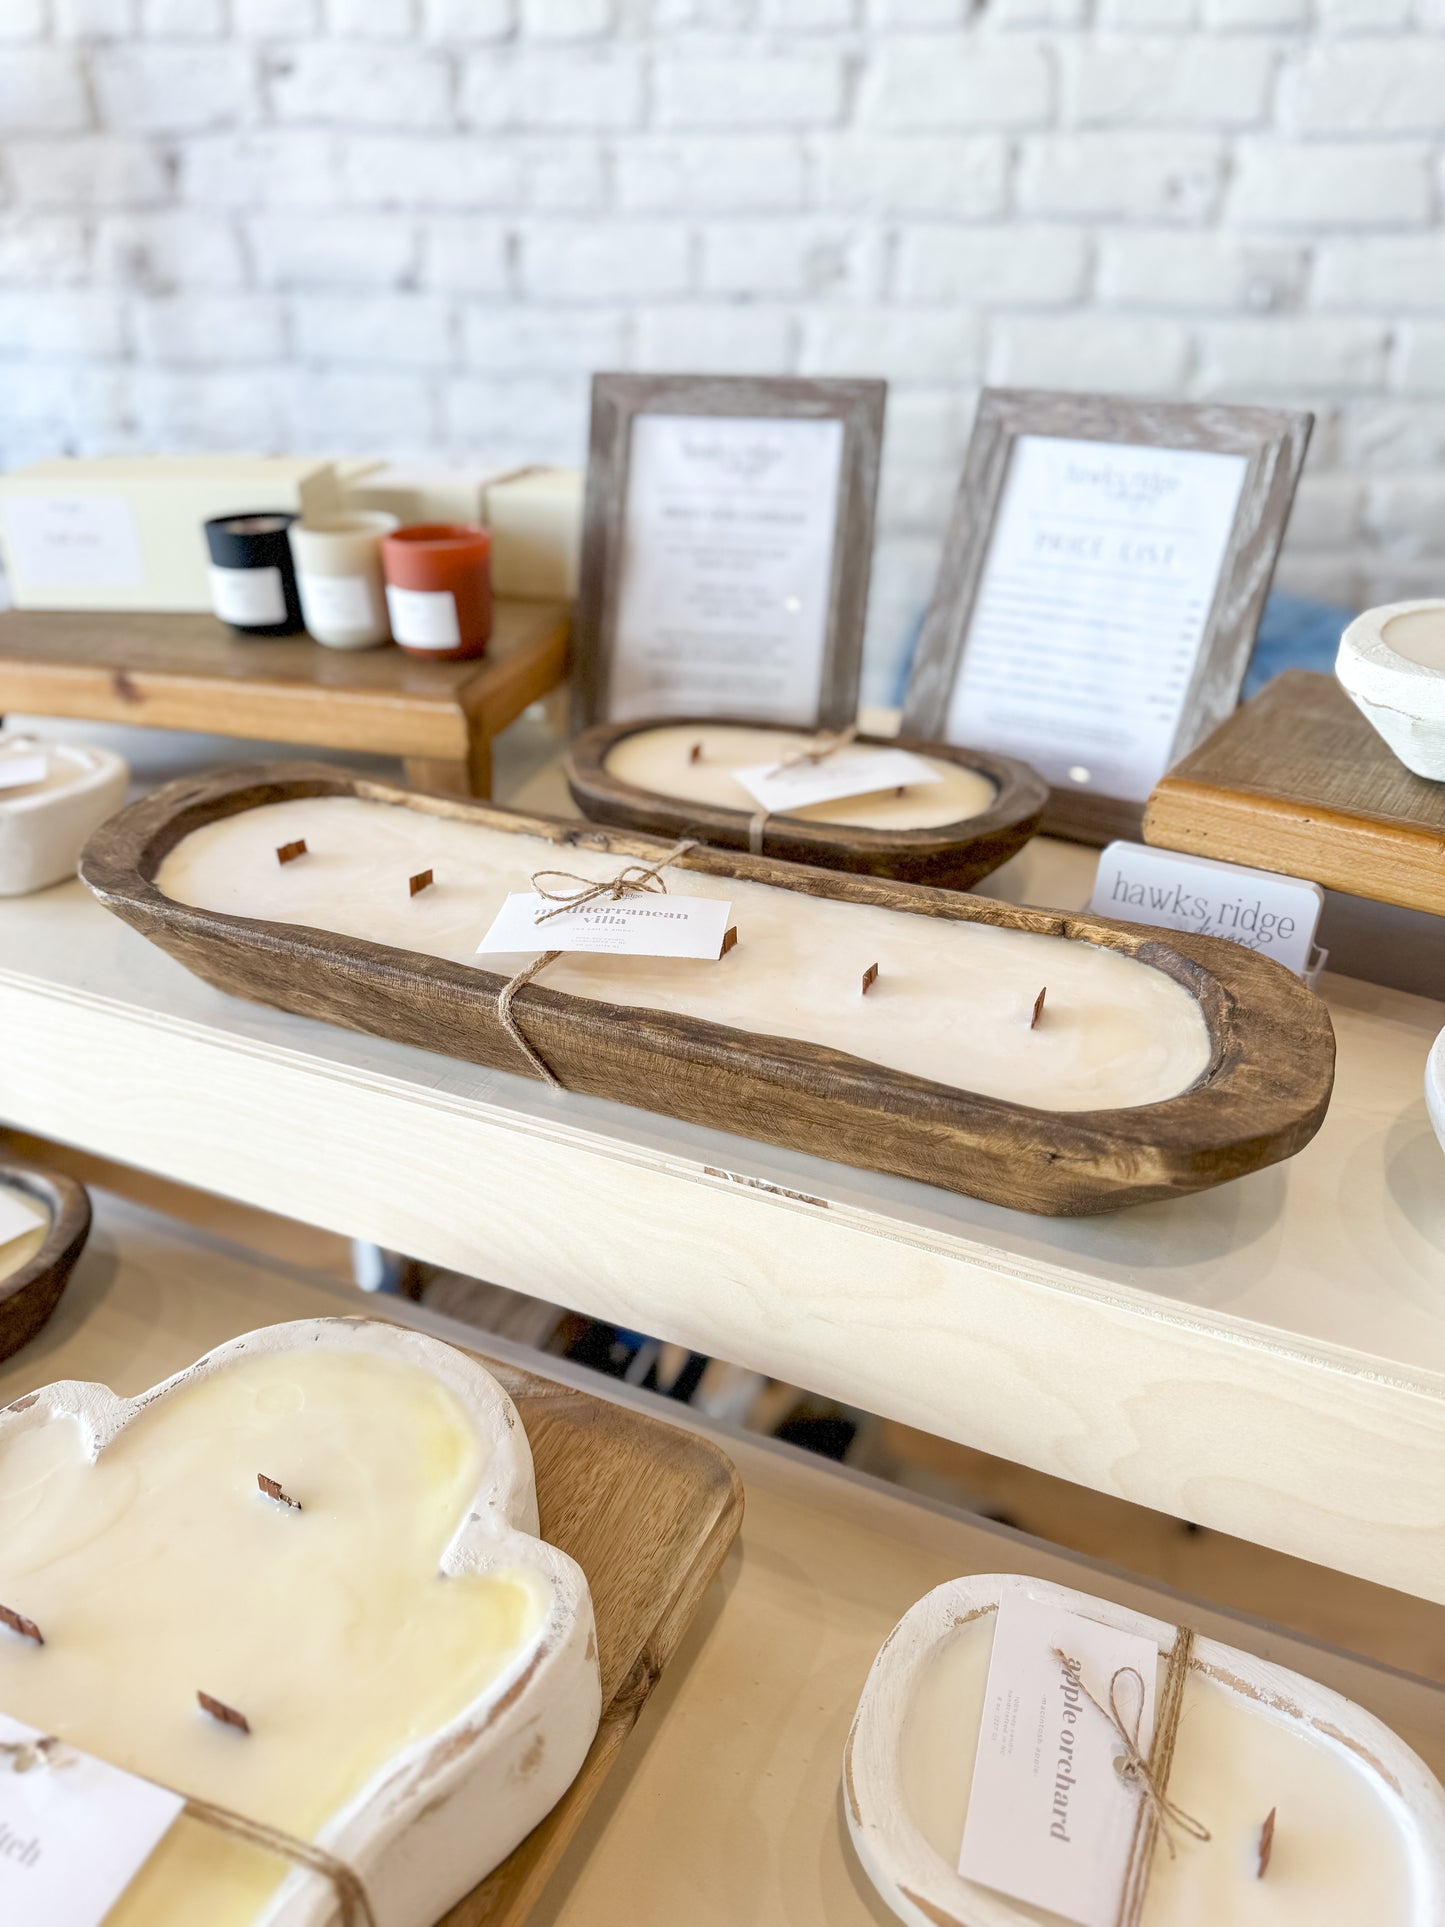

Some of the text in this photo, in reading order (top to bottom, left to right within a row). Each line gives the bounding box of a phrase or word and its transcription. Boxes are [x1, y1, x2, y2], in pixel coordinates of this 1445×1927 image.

[533, 904, 690, 920] mditerranean
[583, 915, 627, 925] villa
[1112, 871, 1295, 943] hawks ridge
[1050, 1657, 1084, 1843] apple orchard
